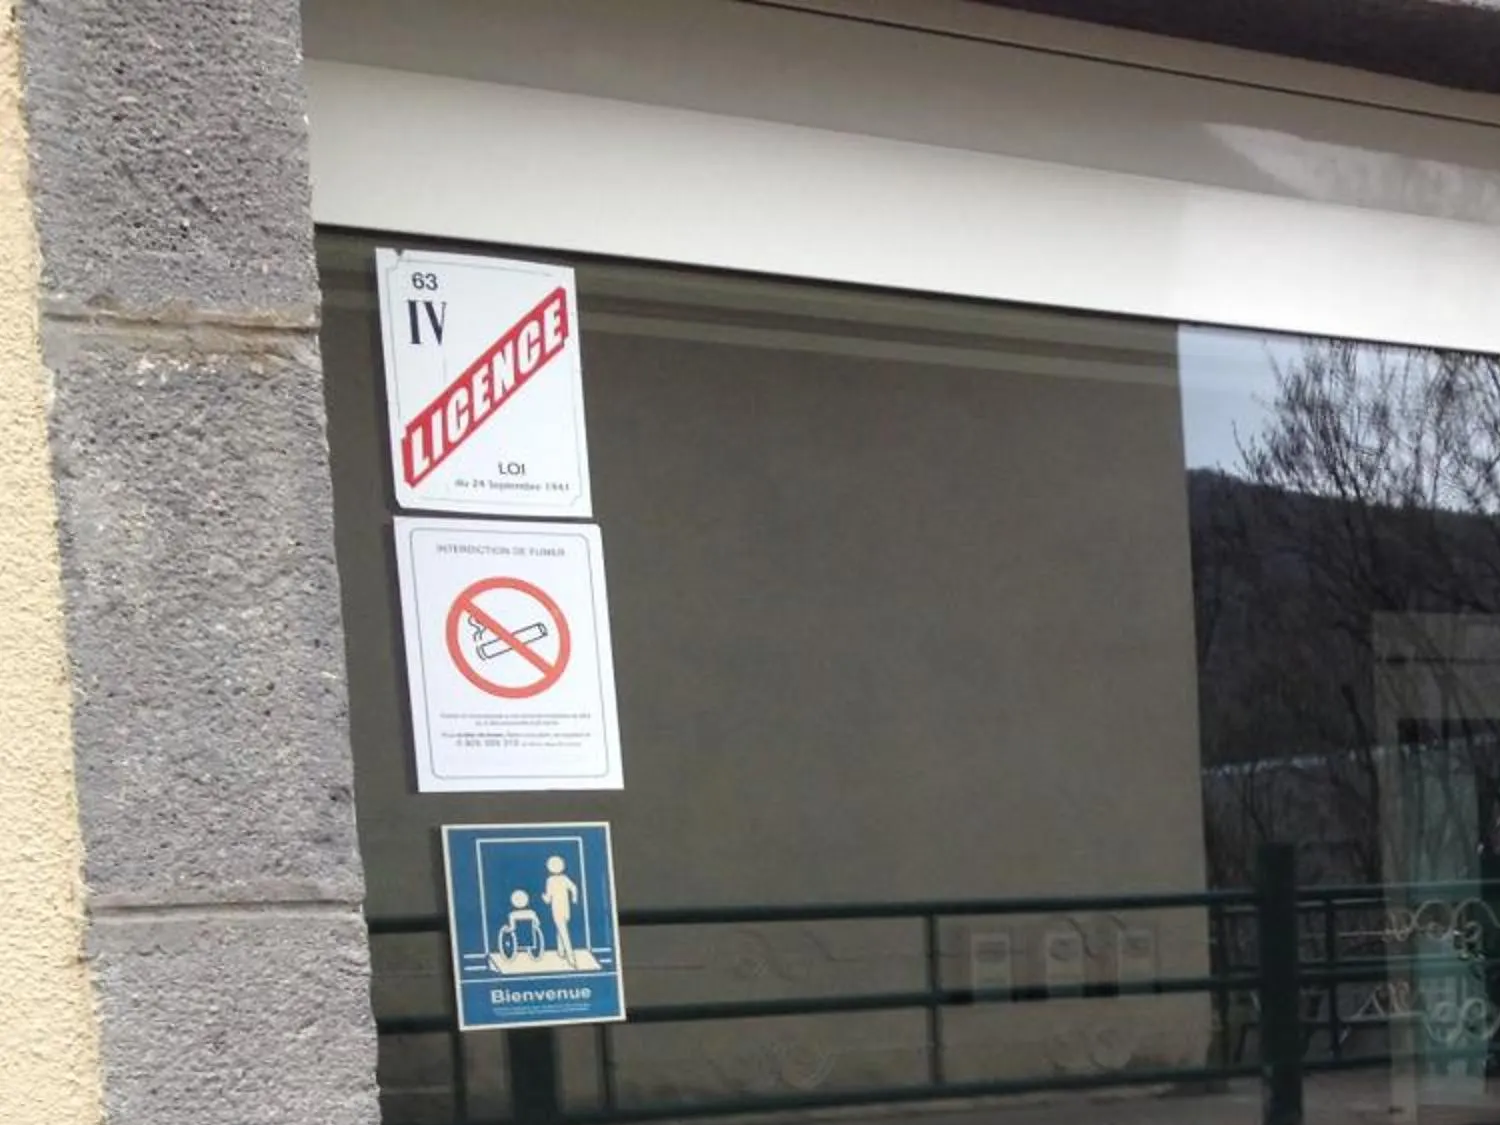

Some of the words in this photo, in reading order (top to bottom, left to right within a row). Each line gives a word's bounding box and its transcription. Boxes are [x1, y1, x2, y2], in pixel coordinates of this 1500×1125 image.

[411, 272, 439, 291] 63
[407, 299, 447, 346] IV
[410, 297, 563, 478] LICENCE
[498, 461, 526, 475] LOI
[491, 986, 592, 1005] Bienvenue
